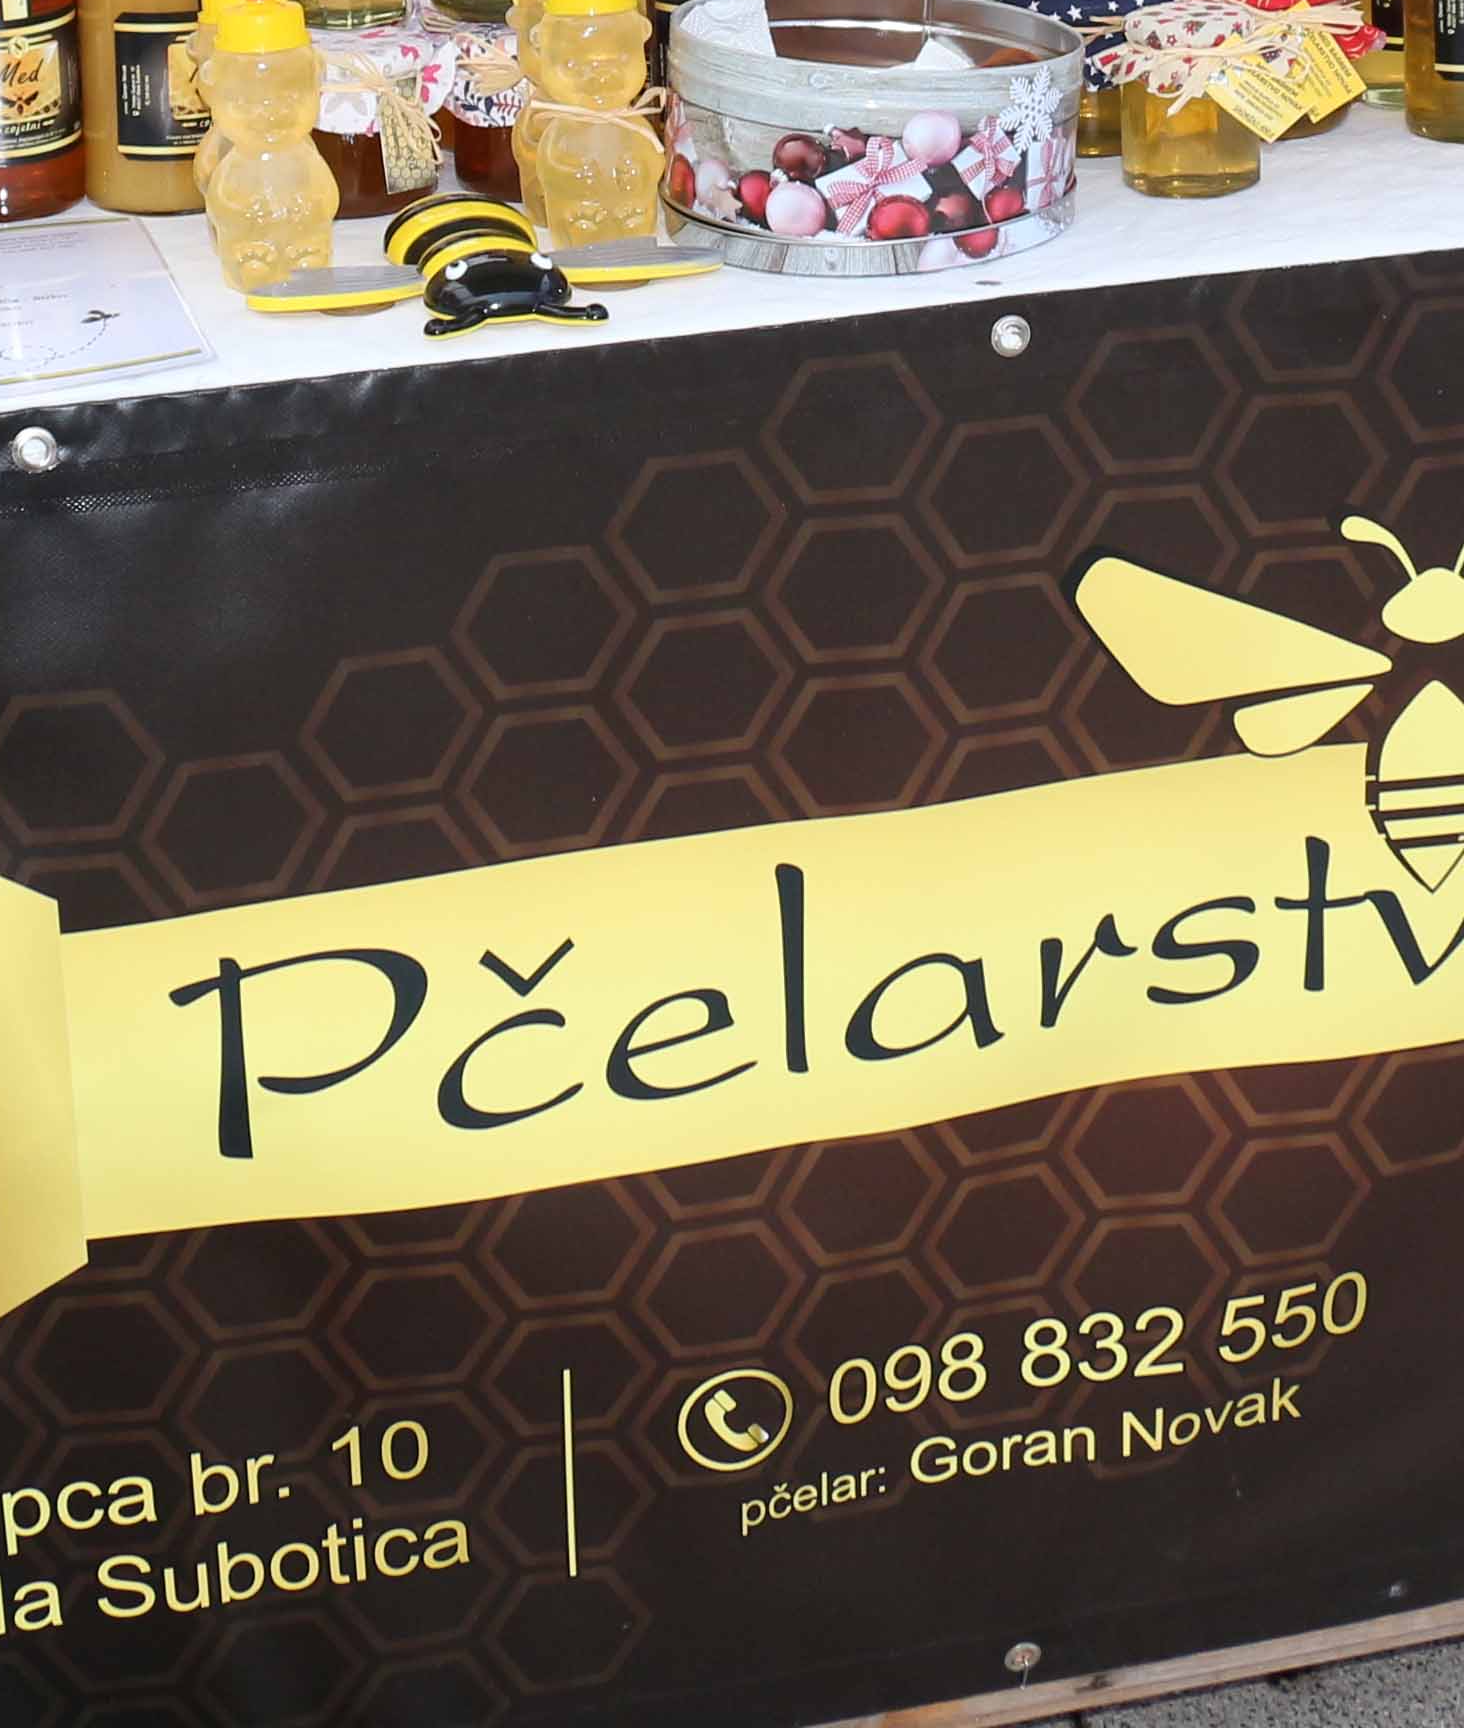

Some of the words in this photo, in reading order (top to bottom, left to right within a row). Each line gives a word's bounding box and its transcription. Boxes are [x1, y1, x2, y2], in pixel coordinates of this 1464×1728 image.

[827, 1331, 989, 1426] 098
[1019, 1305, 1186, 1389] 832
[1216, 1270, 1369, 1364] 550
[189, 1450, 292, 1517] br.
[331, 1419, 431, 1487] 10
[738, 1463, 887, 1536] pčelar:
[908, 1423, 1097, 1486] Goran
[1121, 1376, 1303, 1455] Novak
[95, 1512, 472, 1619] Subotica
